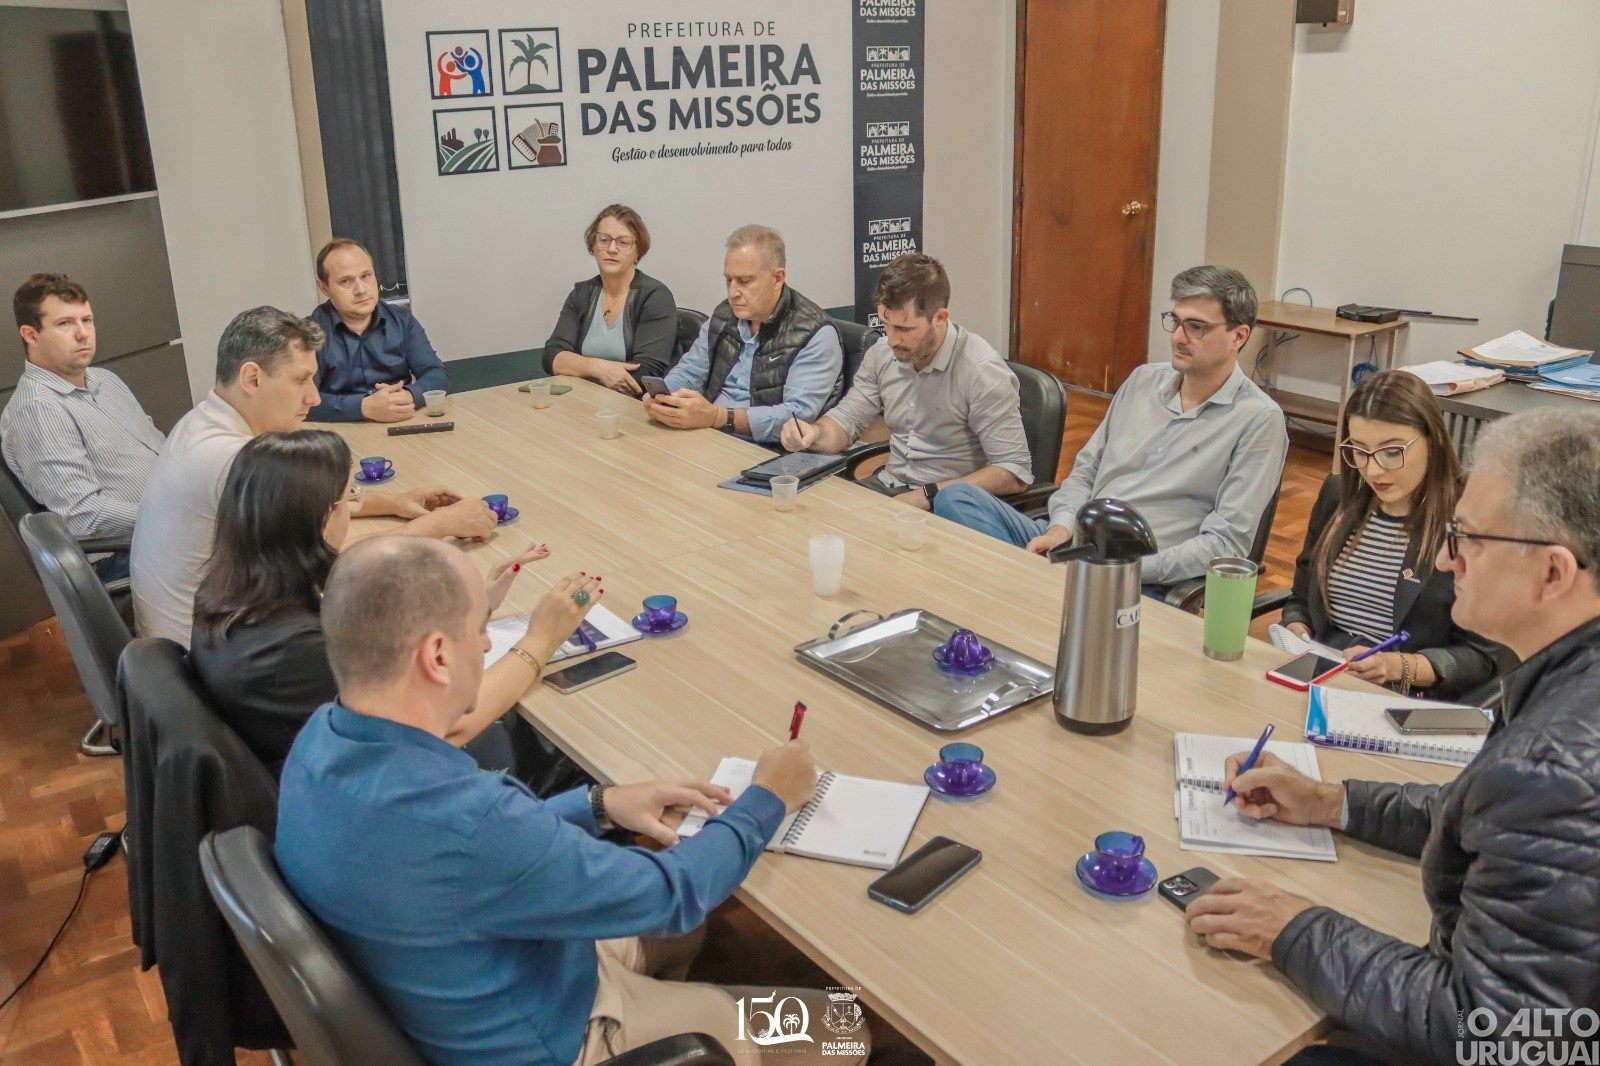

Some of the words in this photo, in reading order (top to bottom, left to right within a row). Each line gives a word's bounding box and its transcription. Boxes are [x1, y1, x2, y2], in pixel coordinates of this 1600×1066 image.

[860, 7, 877, 16] DAS
[879, 5, 916, 16] MISSÕES
[627, 21, 745, 38] PREFEITURA
[754, 21, 776, 36] DE
[577, 43, 822, 94] PALMEIRA
[860, 68, 916, 81] PALMEIRA
[860, 81, 878, 91] DAS
[879, 79, 916, 90] MISSÕES
[580, 99, 657, 136] DAS
[668, 82, 822, 131] MISSÕES
[612, 146, 647, 163] Gestão
[649, 149, 656, 159] e
[657, 140, 739, 159] desenvolvimento
[740, 141, 765, 158] para
[766, 137, 793, 152] todos
[860, 142, 916, 157] PALMEIRA
[860, 157, 878, 167] DAS
[879, 153, 916, 165] MISSÕES
[863, 237, 917, 253] PALMEIRA
[863, 253, 880, 263] DAS
